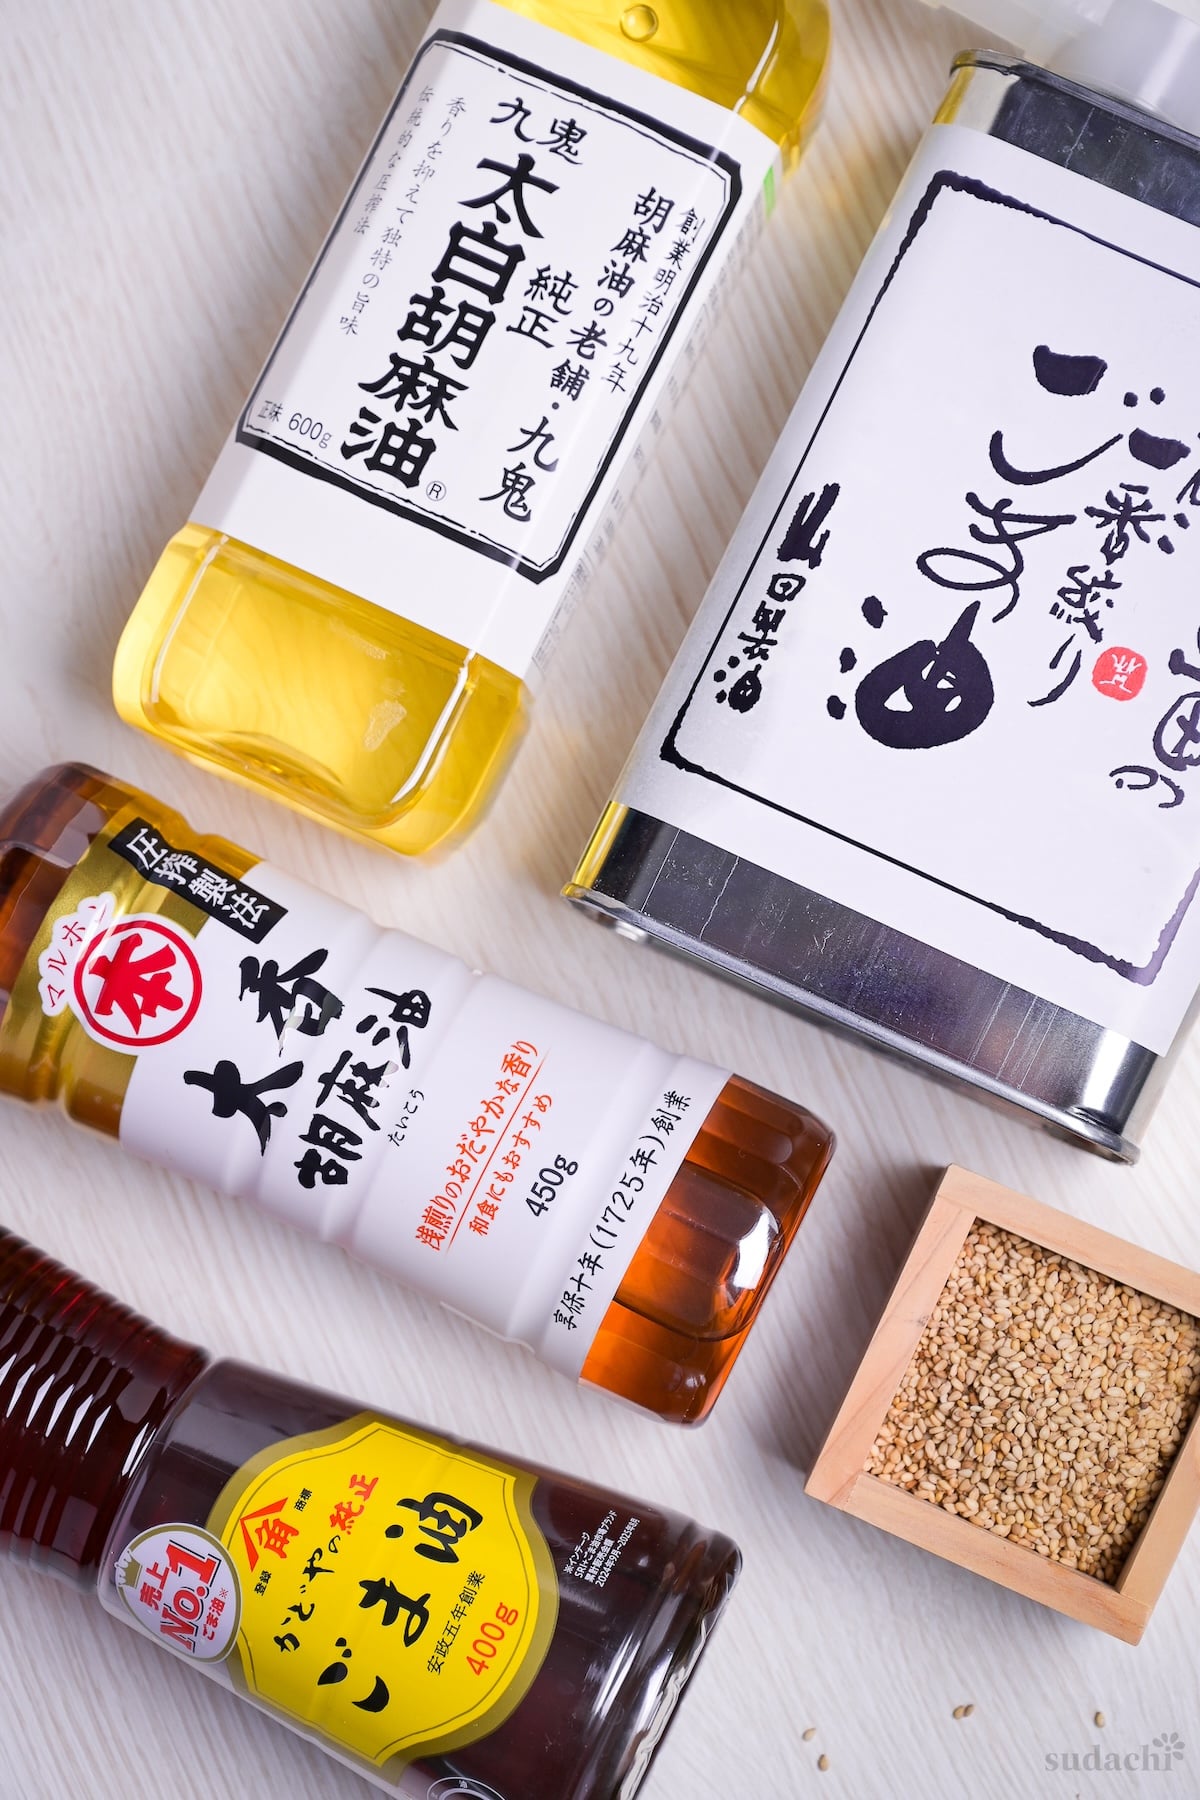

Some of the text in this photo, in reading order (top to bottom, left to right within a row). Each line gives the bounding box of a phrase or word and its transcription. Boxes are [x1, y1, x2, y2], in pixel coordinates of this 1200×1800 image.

[353, 85, 435, 236] 伝統的な圧搾法
[489, 96, 588, 165] 九鬼
[339, 96, 467, 337] 香りを抑えて独特の旨味
[340, 152, 561, 489] 太白胡麻油
[505, 264, 579, 350] 純正
[600, 206, 706, 394] 創業明治十九年
[257, 400, 333, 450] 正味 600g
[126, 827, 270, 930] 圧搾製法
[293, 987, 433, 1189] 胡麻油
[387, 1088, 425, 1147] たいこう
[414, 1039, 539, 1252] 浅煎りのおだやかな香り
[468, 1093, 553, 1237] 和食にもおすすめ
[525, 1153, 579, 1218] 450g
[140, 1561, 171, 1612] 売上
[316, 1491, 484, 1713] ごま油
[426, 1569, 486, 1676] 安政五年創業
[465, 1601, 520, 1677] 400g
